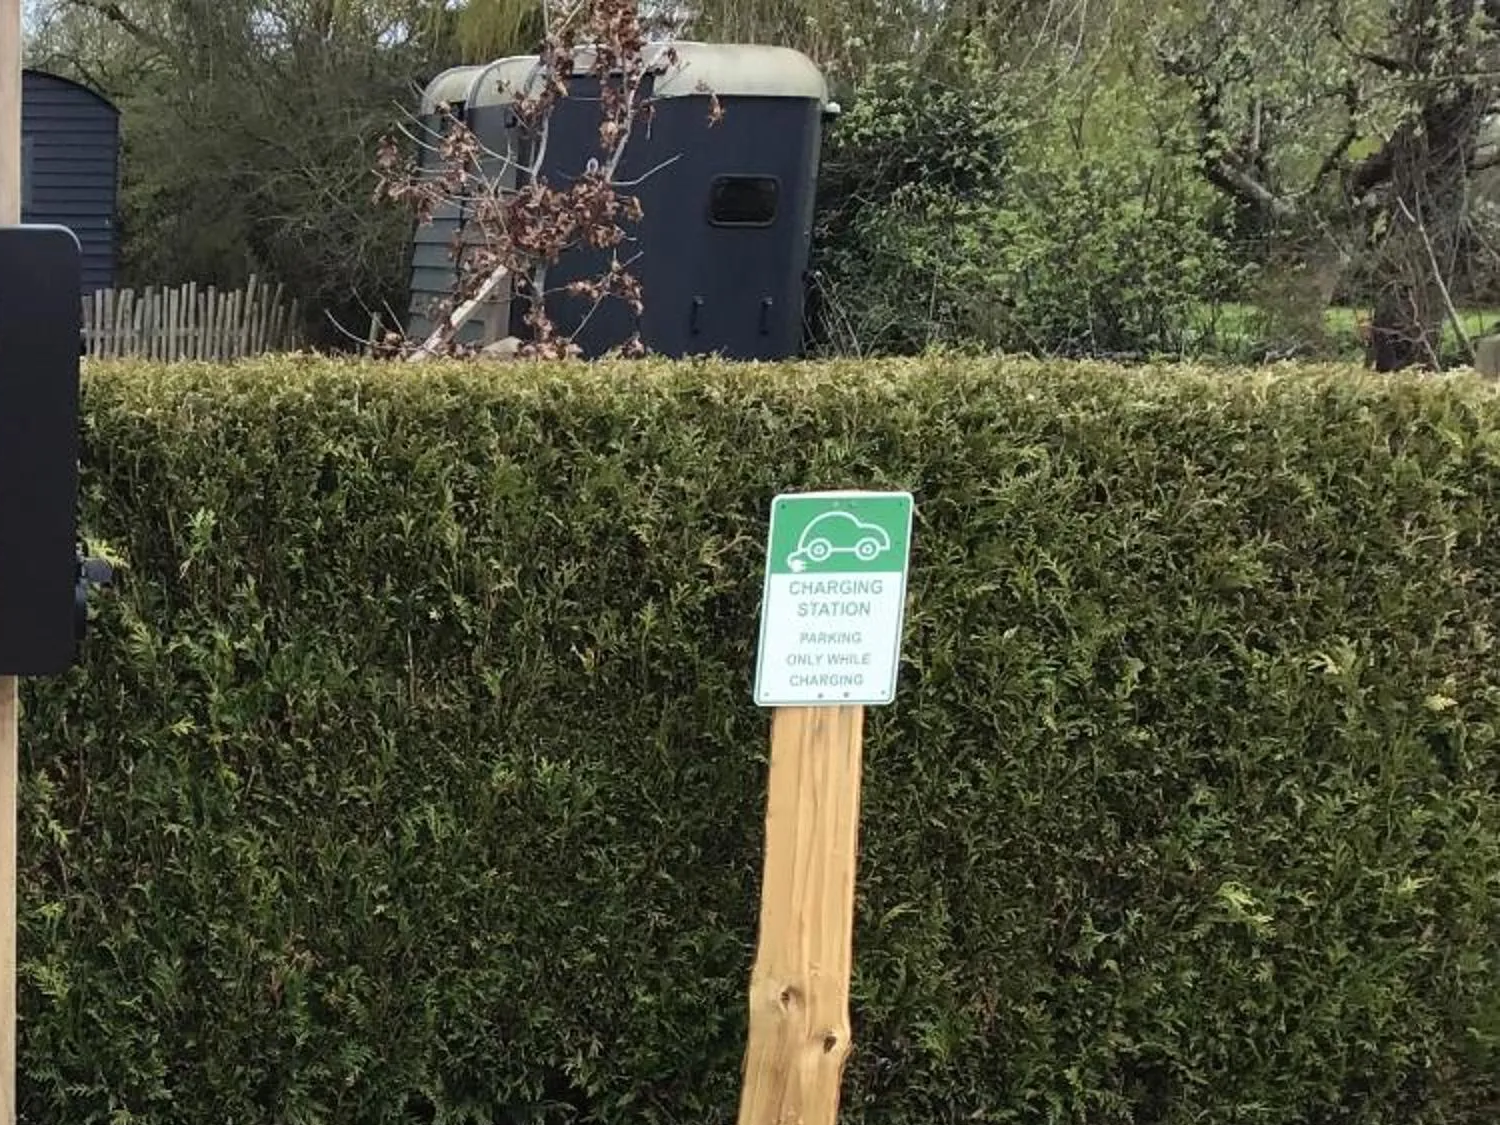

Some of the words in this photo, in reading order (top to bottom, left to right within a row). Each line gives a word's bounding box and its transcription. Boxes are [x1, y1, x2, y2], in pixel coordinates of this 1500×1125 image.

[788, 579, 883, 595] CHARGING
[797, 601, 871, 617] STATION
[799, 631, 863, 644] PARKING
[786, 653, 823, 666] ONLY
[827, 652, 871, 666] WHILE
[789, 673, 864, 687] CHARGING
